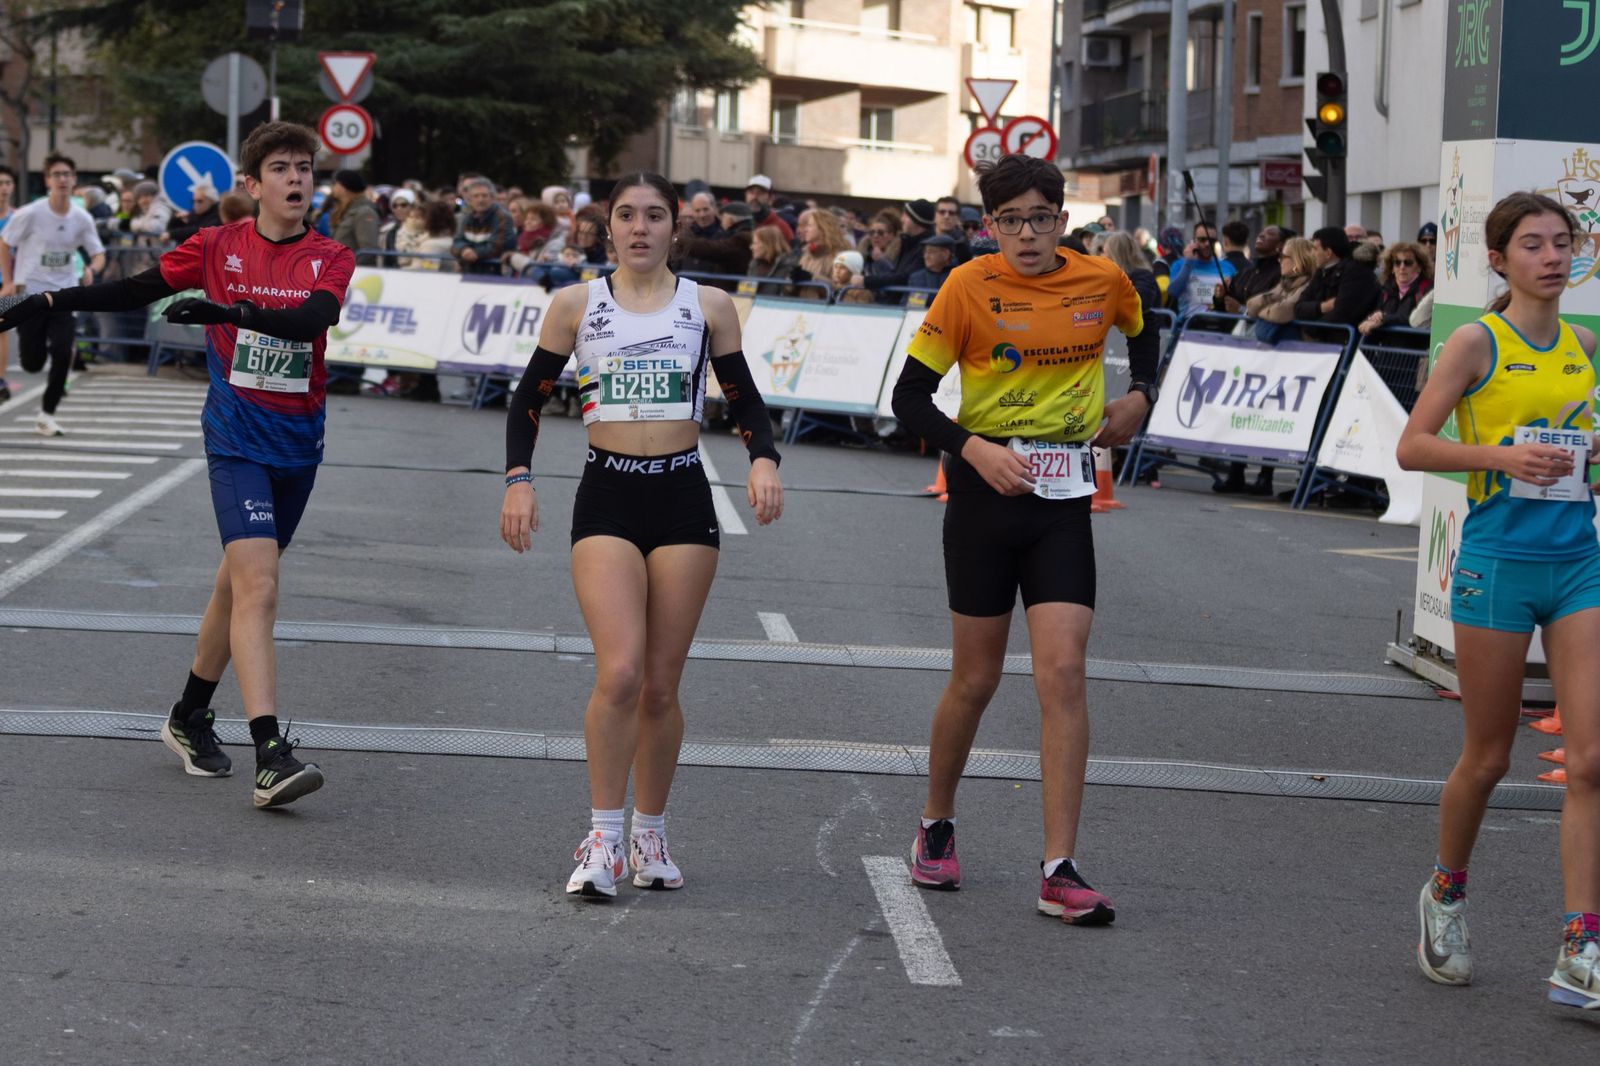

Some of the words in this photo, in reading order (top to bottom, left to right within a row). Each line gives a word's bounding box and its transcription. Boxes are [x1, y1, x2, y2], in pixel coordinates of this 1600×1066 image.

[332, 122, 360, 139] 30
[975, 143, 1001, 160] 30
[227, 283, 248, 294] A.D.
[252, 286, 311, 299] MARATHO
[346, 303, 418, 326] SETEL
[258, 336, 307, 350] SETEL
[1024, 346, 1069, 357] ESCUELA
[247, 347, 293, 374] 6172
[623, 359, 682, 370] SETEL
[611, 373, 670, 399] 6293
[1230, 411, 1295, 434] fertilizantes
[1539, 432, 1588, 446] SETEL
[604, 455, 666, 474] NIKE
